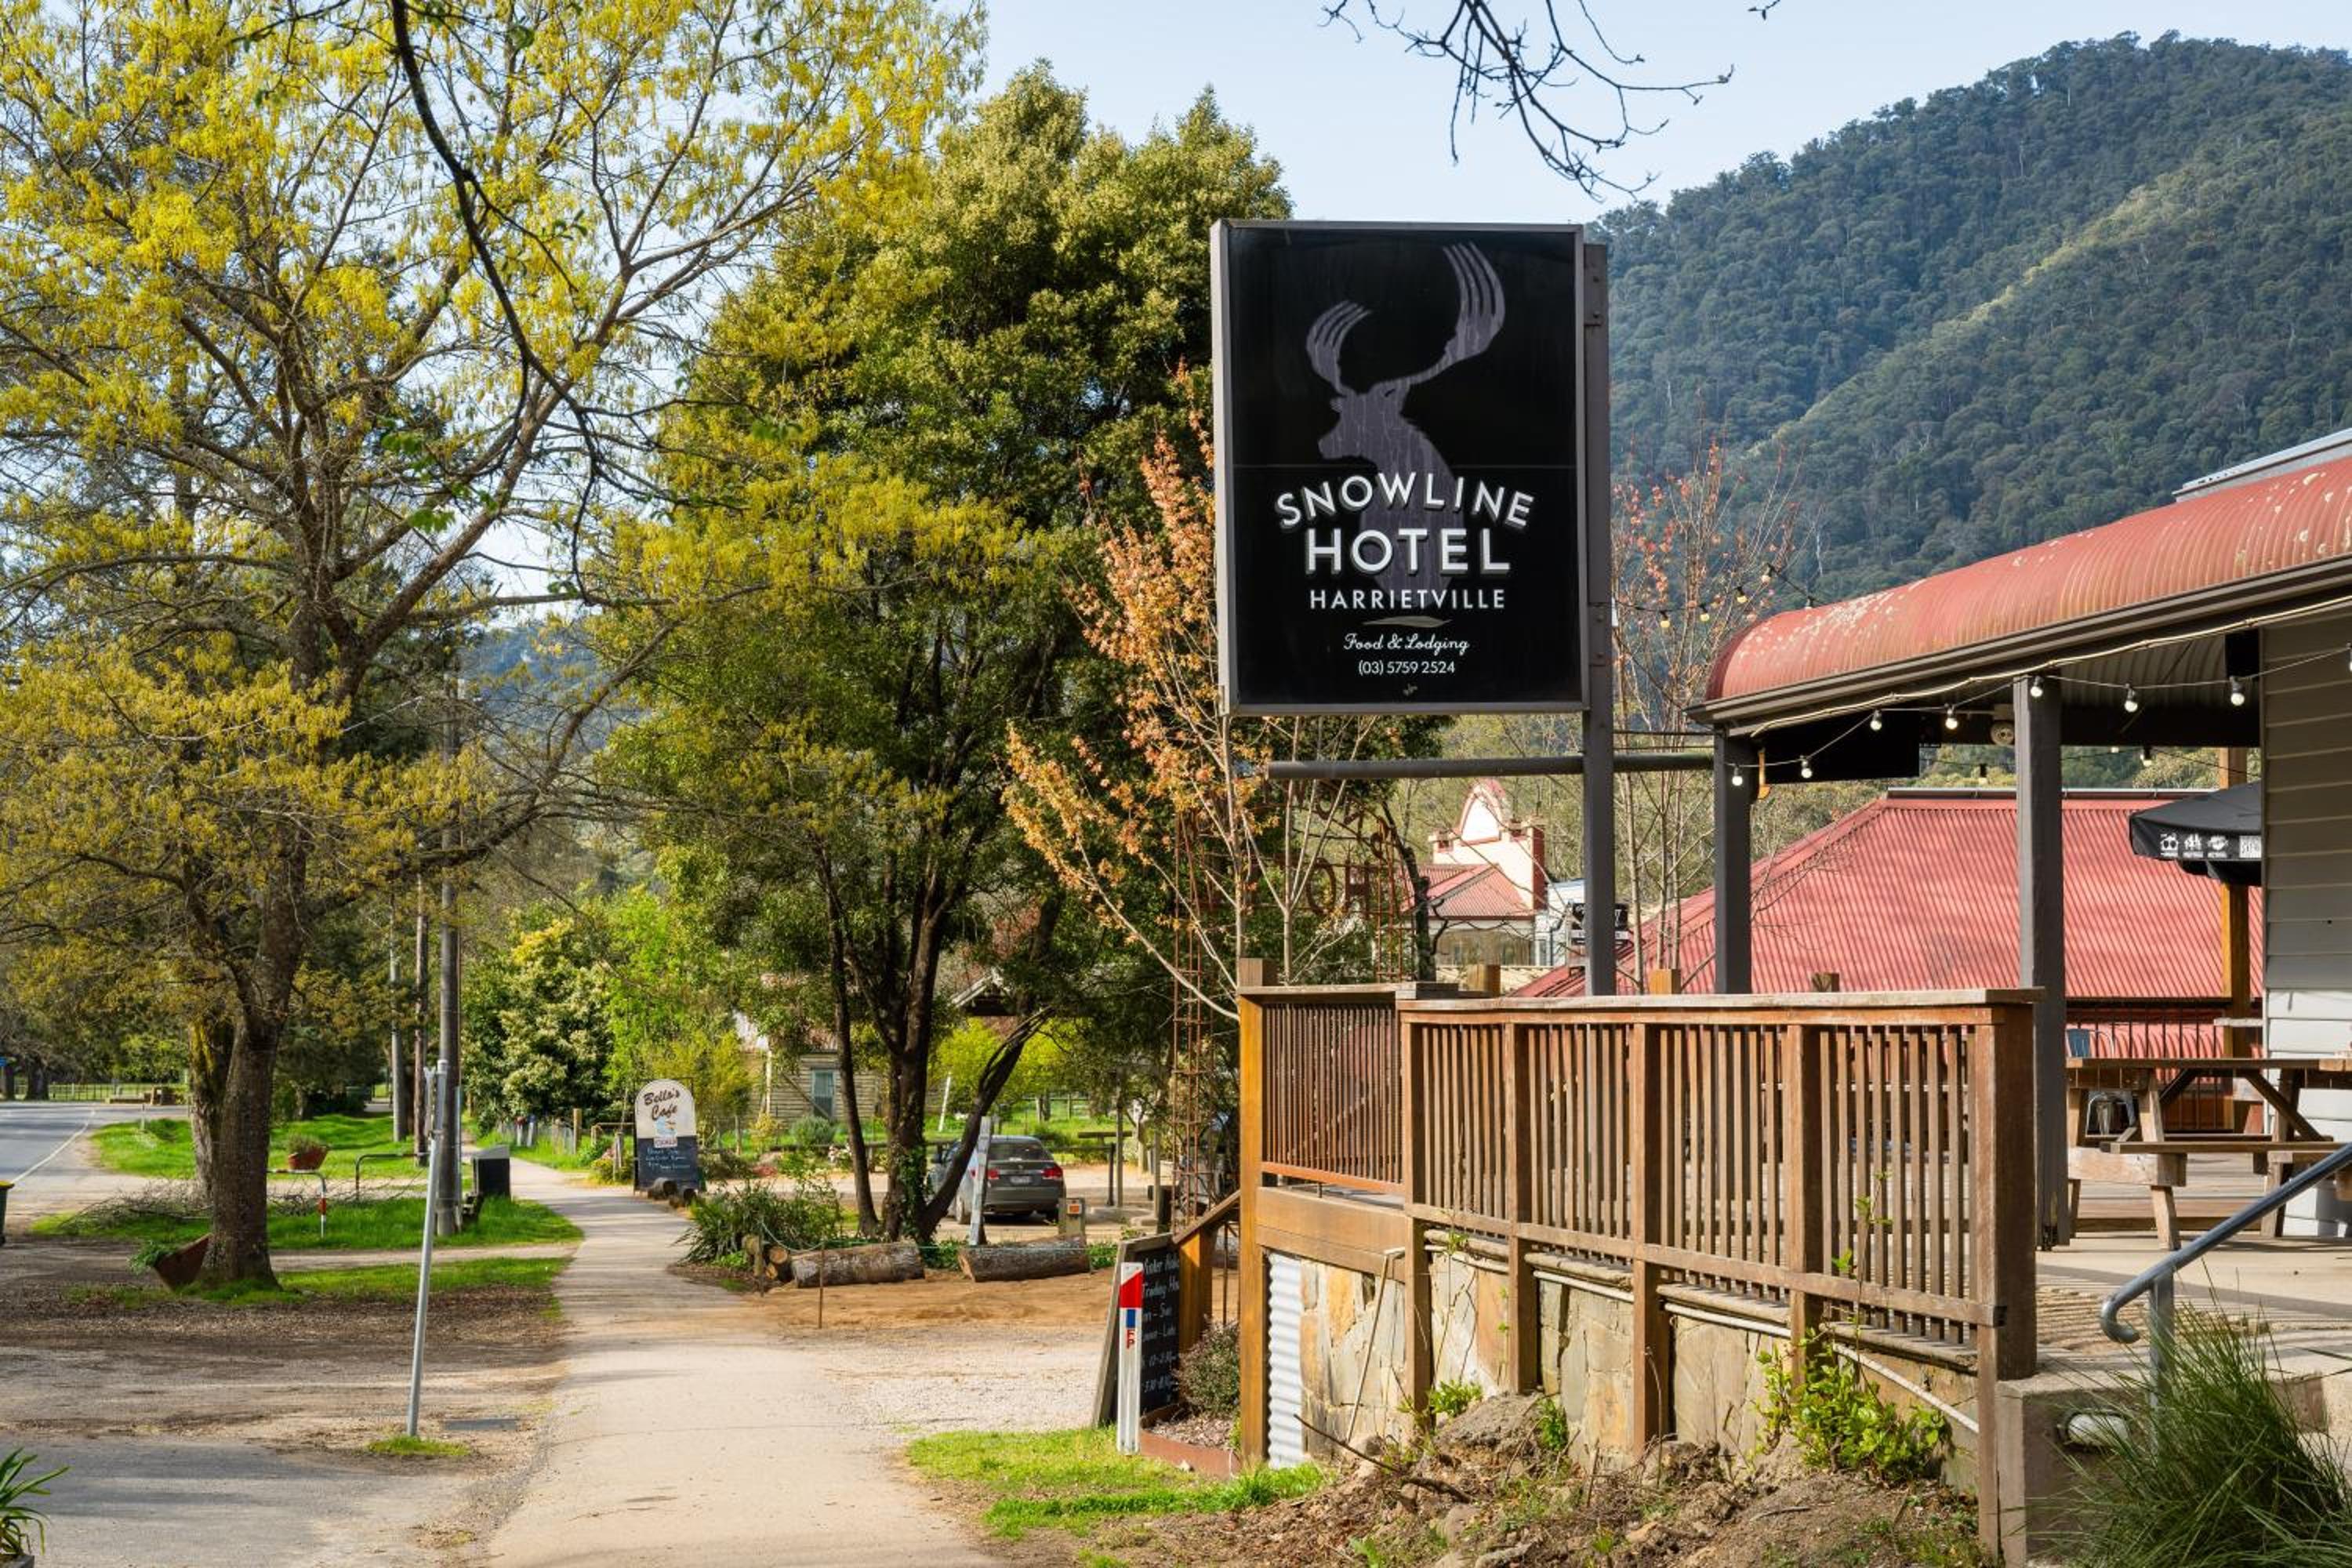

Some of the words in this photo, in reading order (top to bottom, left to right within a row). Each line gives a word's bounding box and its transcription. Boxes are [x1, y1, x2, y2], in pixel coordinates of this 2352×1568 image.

[1276, 472, 1534, 528] SNOWLINE
[1305, 528, 1511, 575] HOTEL
[1310, 590, 1505, 609] HARRIETVILLE
[1343, 633, 1383, 650] Food
[1387, 633, 1403, 649] &
[1404, 633, 1470, 656] Lodging
[1359, 660, 1384, 676] (03)
[1387, 662, 1418, 673] 5759
[1421, 662, 1455, 673] 2524
